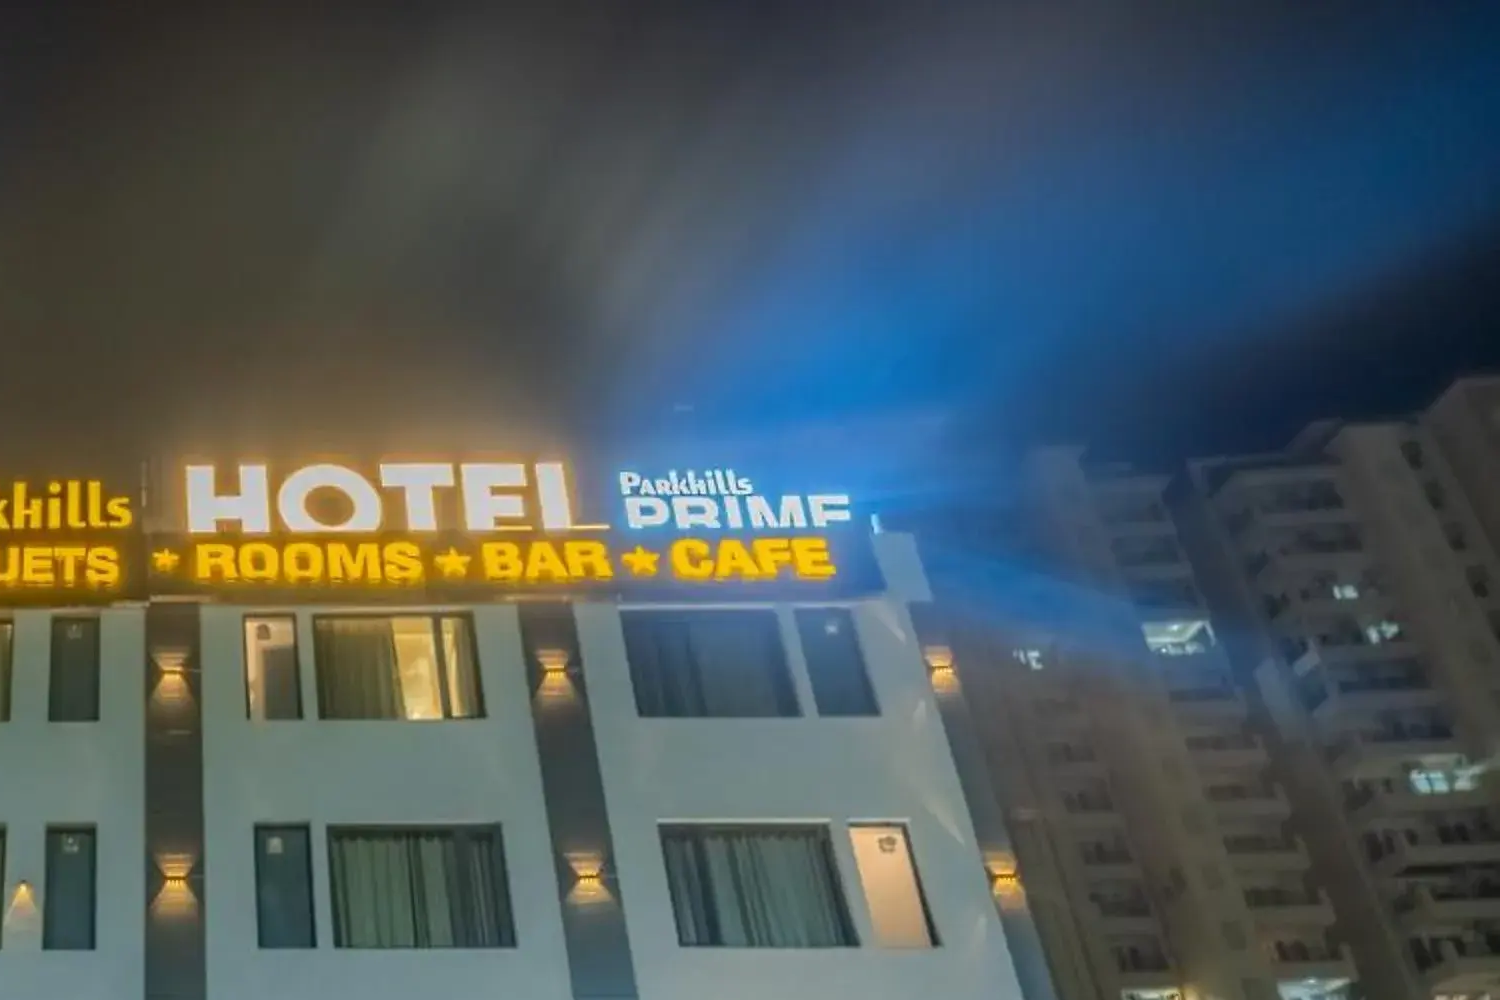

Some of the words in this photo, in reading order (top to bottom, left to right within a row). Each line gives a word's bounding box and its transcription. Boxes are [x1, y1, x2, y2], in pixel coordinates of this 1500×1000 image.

[184, 461, 611, 534] HOTEL
[195, 540, 423, 584] ROOMS
[480, 539, 613, 581] BAR
[670, 537, 837, 581] CAFE
